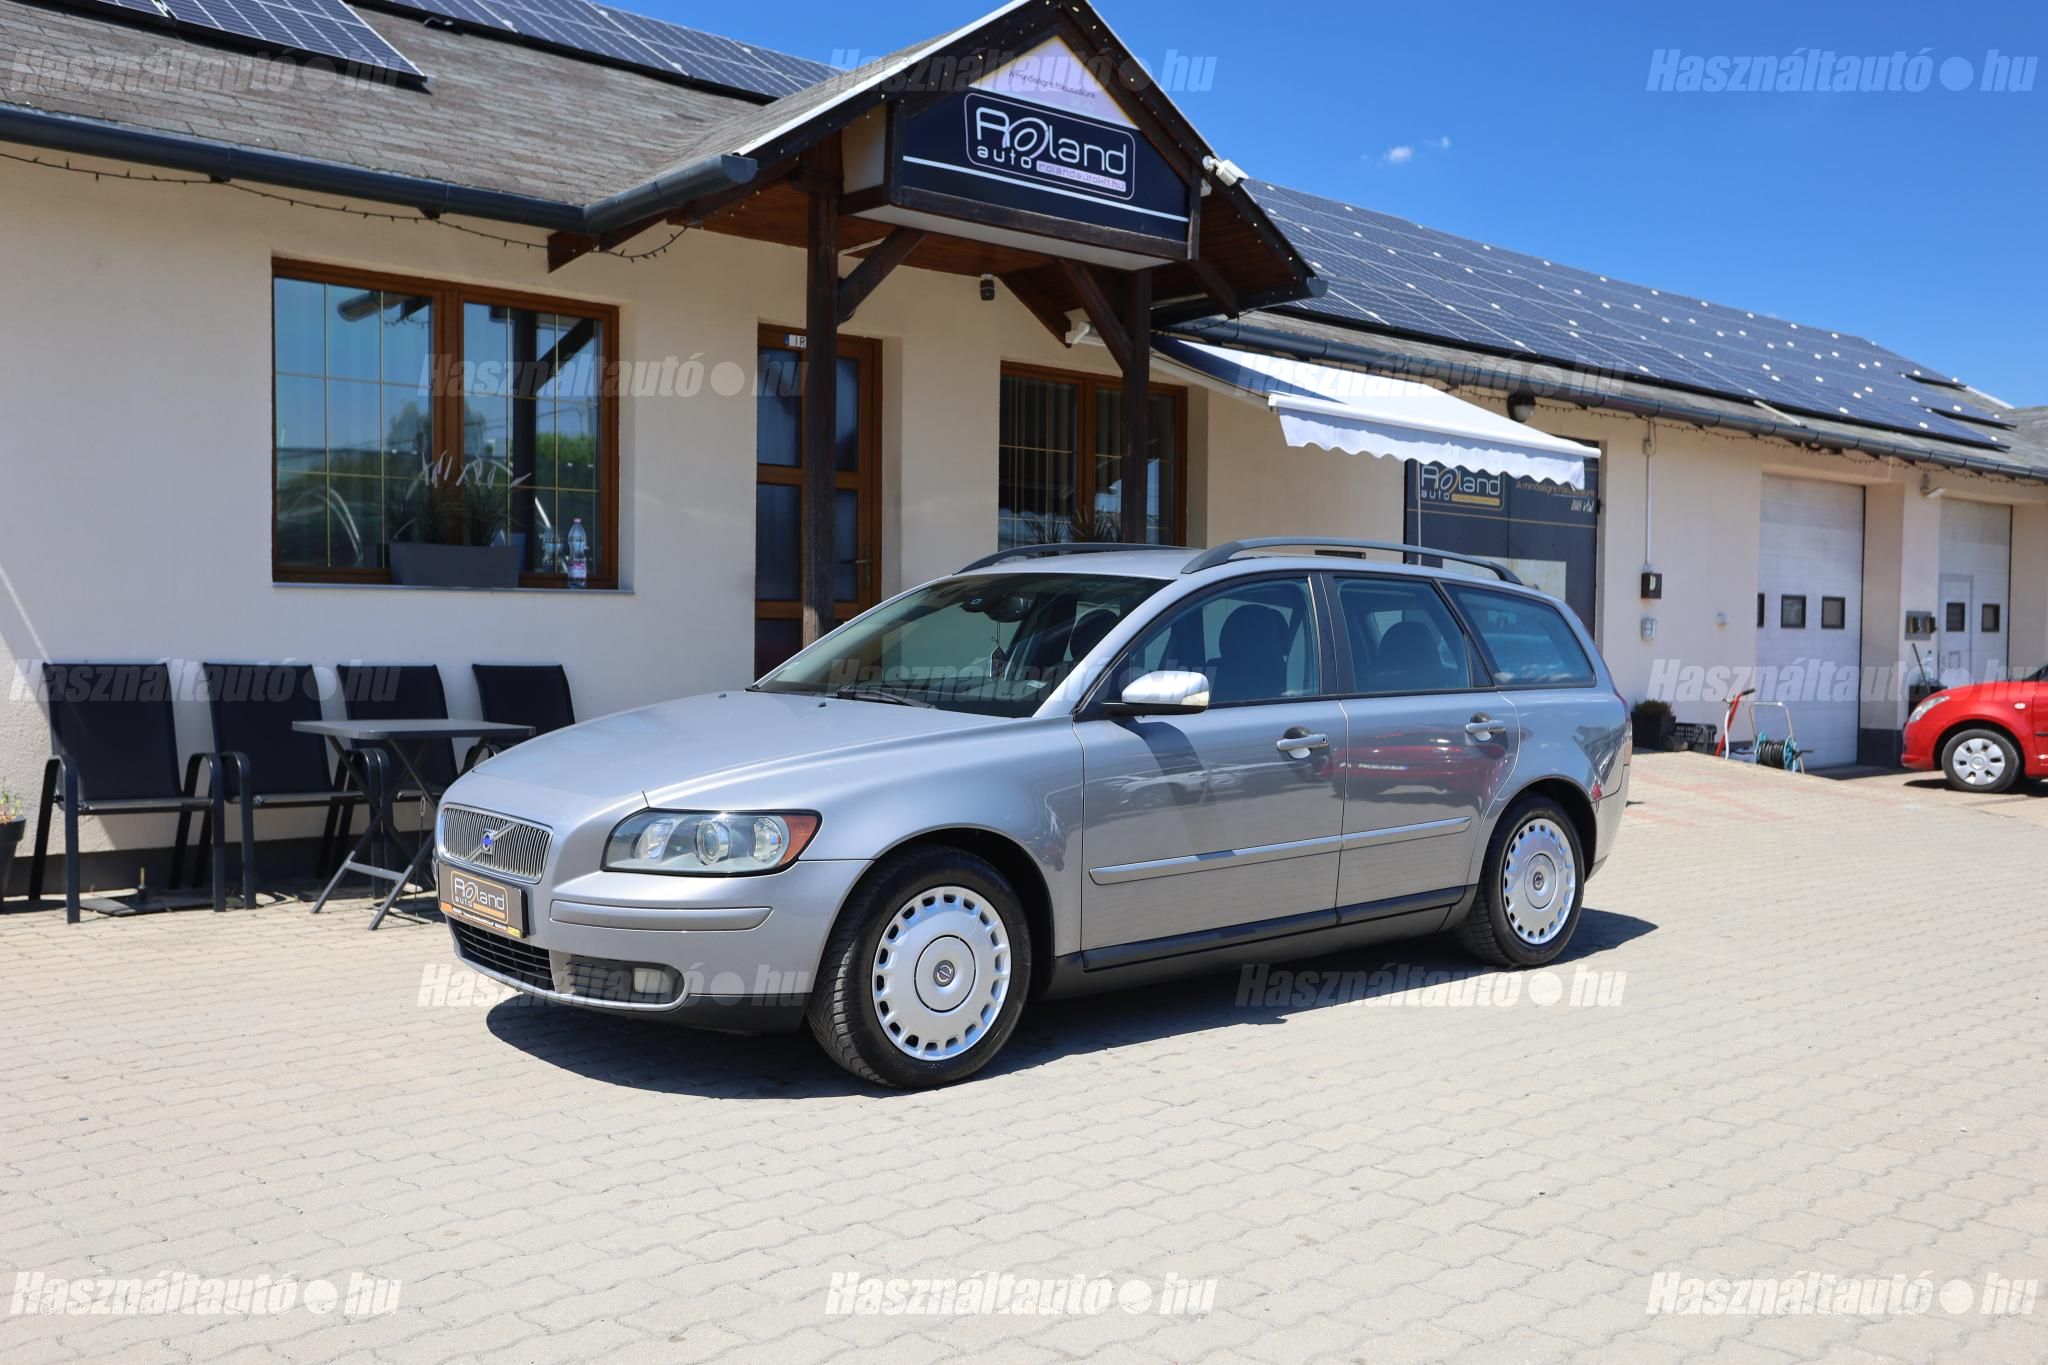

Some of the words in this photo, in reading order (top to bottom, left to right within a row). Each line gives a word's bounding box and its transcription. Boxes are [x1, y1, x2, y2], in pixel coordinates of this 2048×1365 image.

[976, 107, 1126, 175] Roland
[977, 145, 1032, 169] auto
[1421, 466, 1500, 495] Roland
[1421, 490, 1450, 501] auto
[454, 877, 505, 910] Roland
[454, 895, 473, 907] auto
